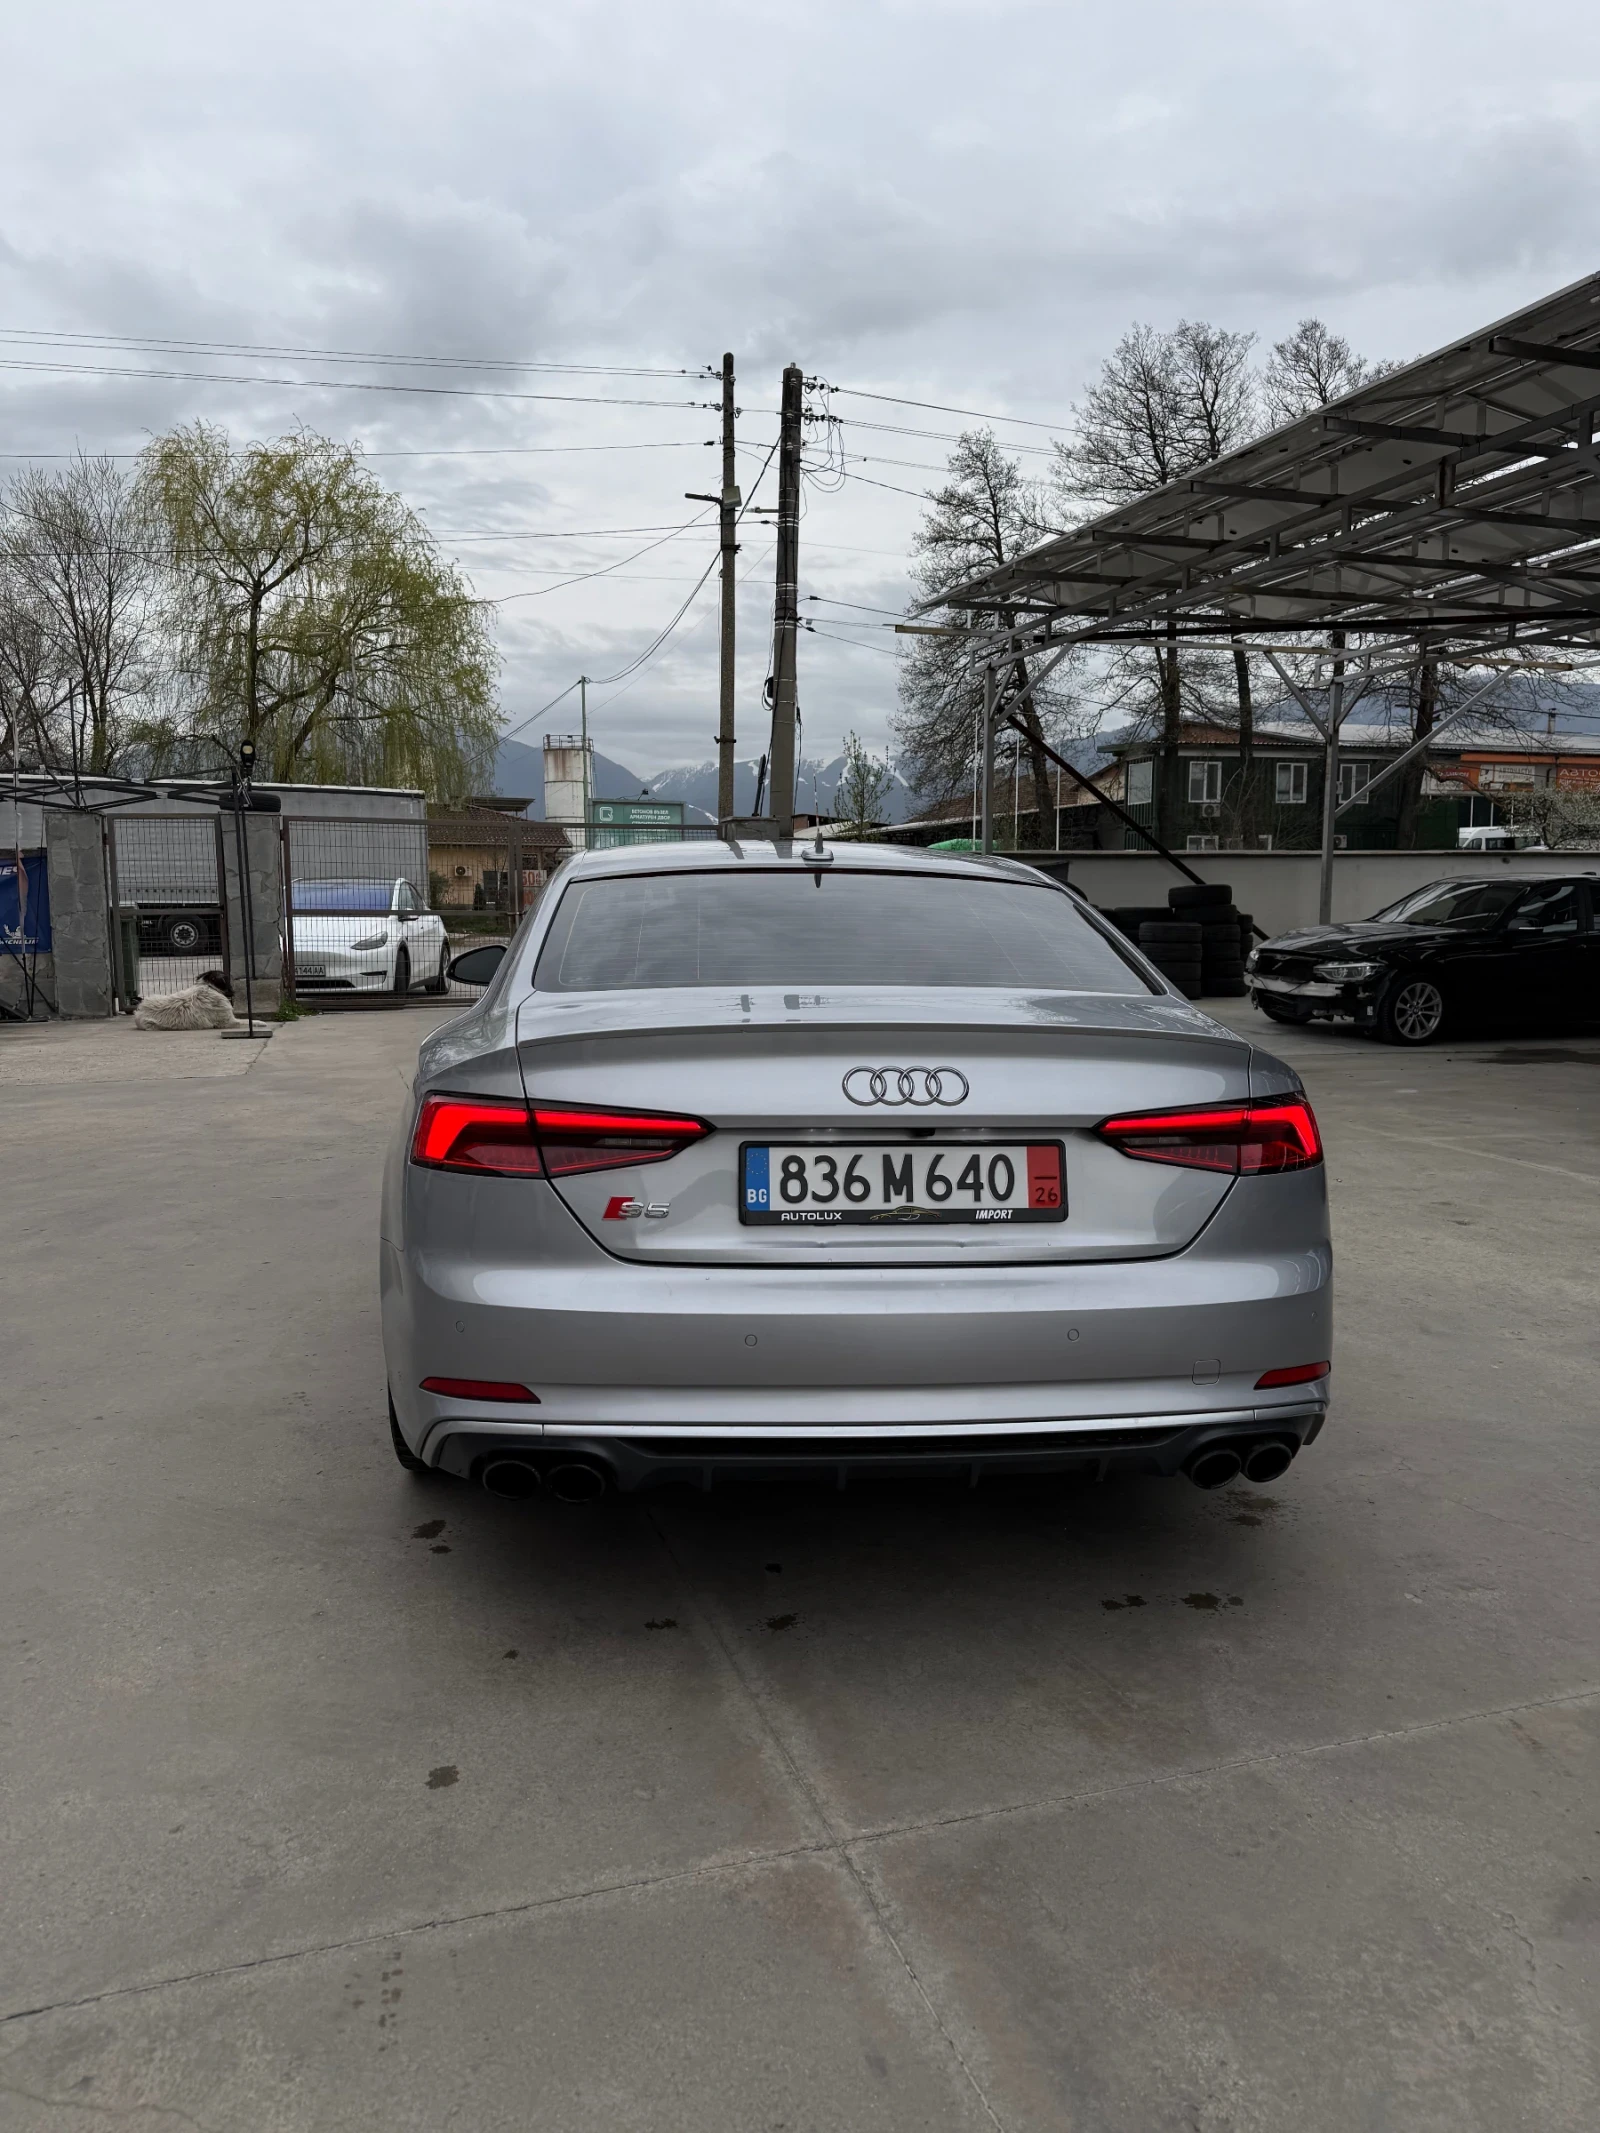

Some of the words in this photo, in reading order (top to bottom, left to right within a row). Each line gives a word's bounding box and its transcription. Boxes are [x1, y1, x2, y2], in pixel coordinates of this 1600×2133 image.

[780, 1154, 871, 1204] 836
[882, 1154, 914, 1203] M
[925, 1153, 1015, 1202] 640
[747, 1188, 767, 1203] BG
[1035, 1187, 1058, 1202] 26
[618, 1201, 671, 1219] S5
[781, 1211, 843, 1221] AUTOLUX
[975, 1209, 1014, 1220] IMPORT
